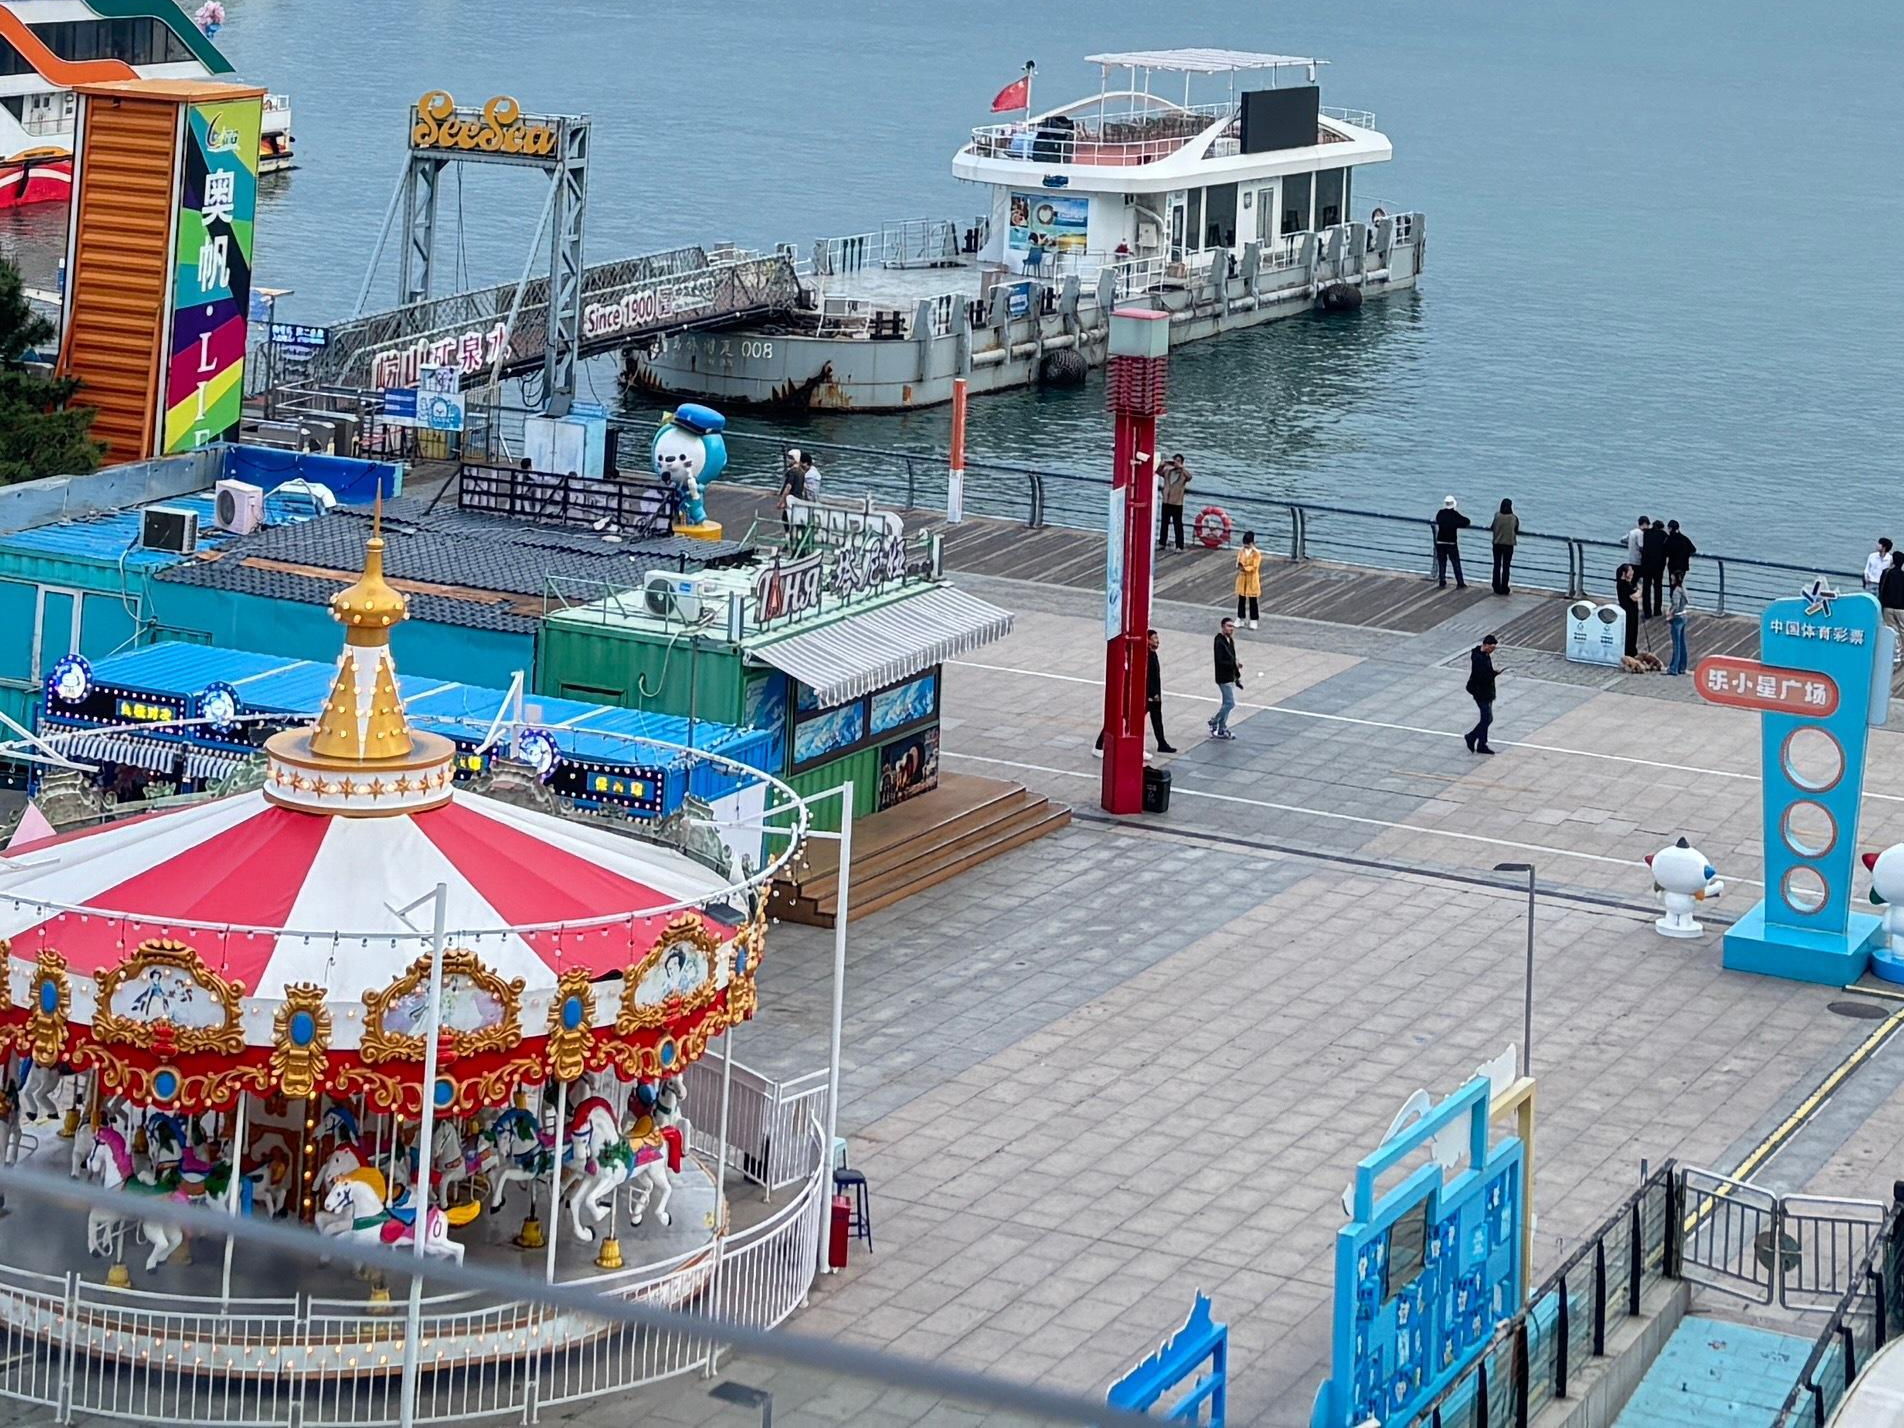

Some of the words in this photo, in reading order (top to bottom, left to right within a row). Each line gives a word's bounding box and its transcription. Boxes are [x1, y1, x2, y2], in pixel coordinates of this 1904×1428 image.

[413, 89, 558, 155] SeeSea
[586, 305, 622, 335] Since
[622, 291, 655, 326] 1900
[741, 340, 773, 359] 008
[1770, 618, 1865, 646] 中国体育彩票
[1707, 668, 1828, 707] 乐小星广场
